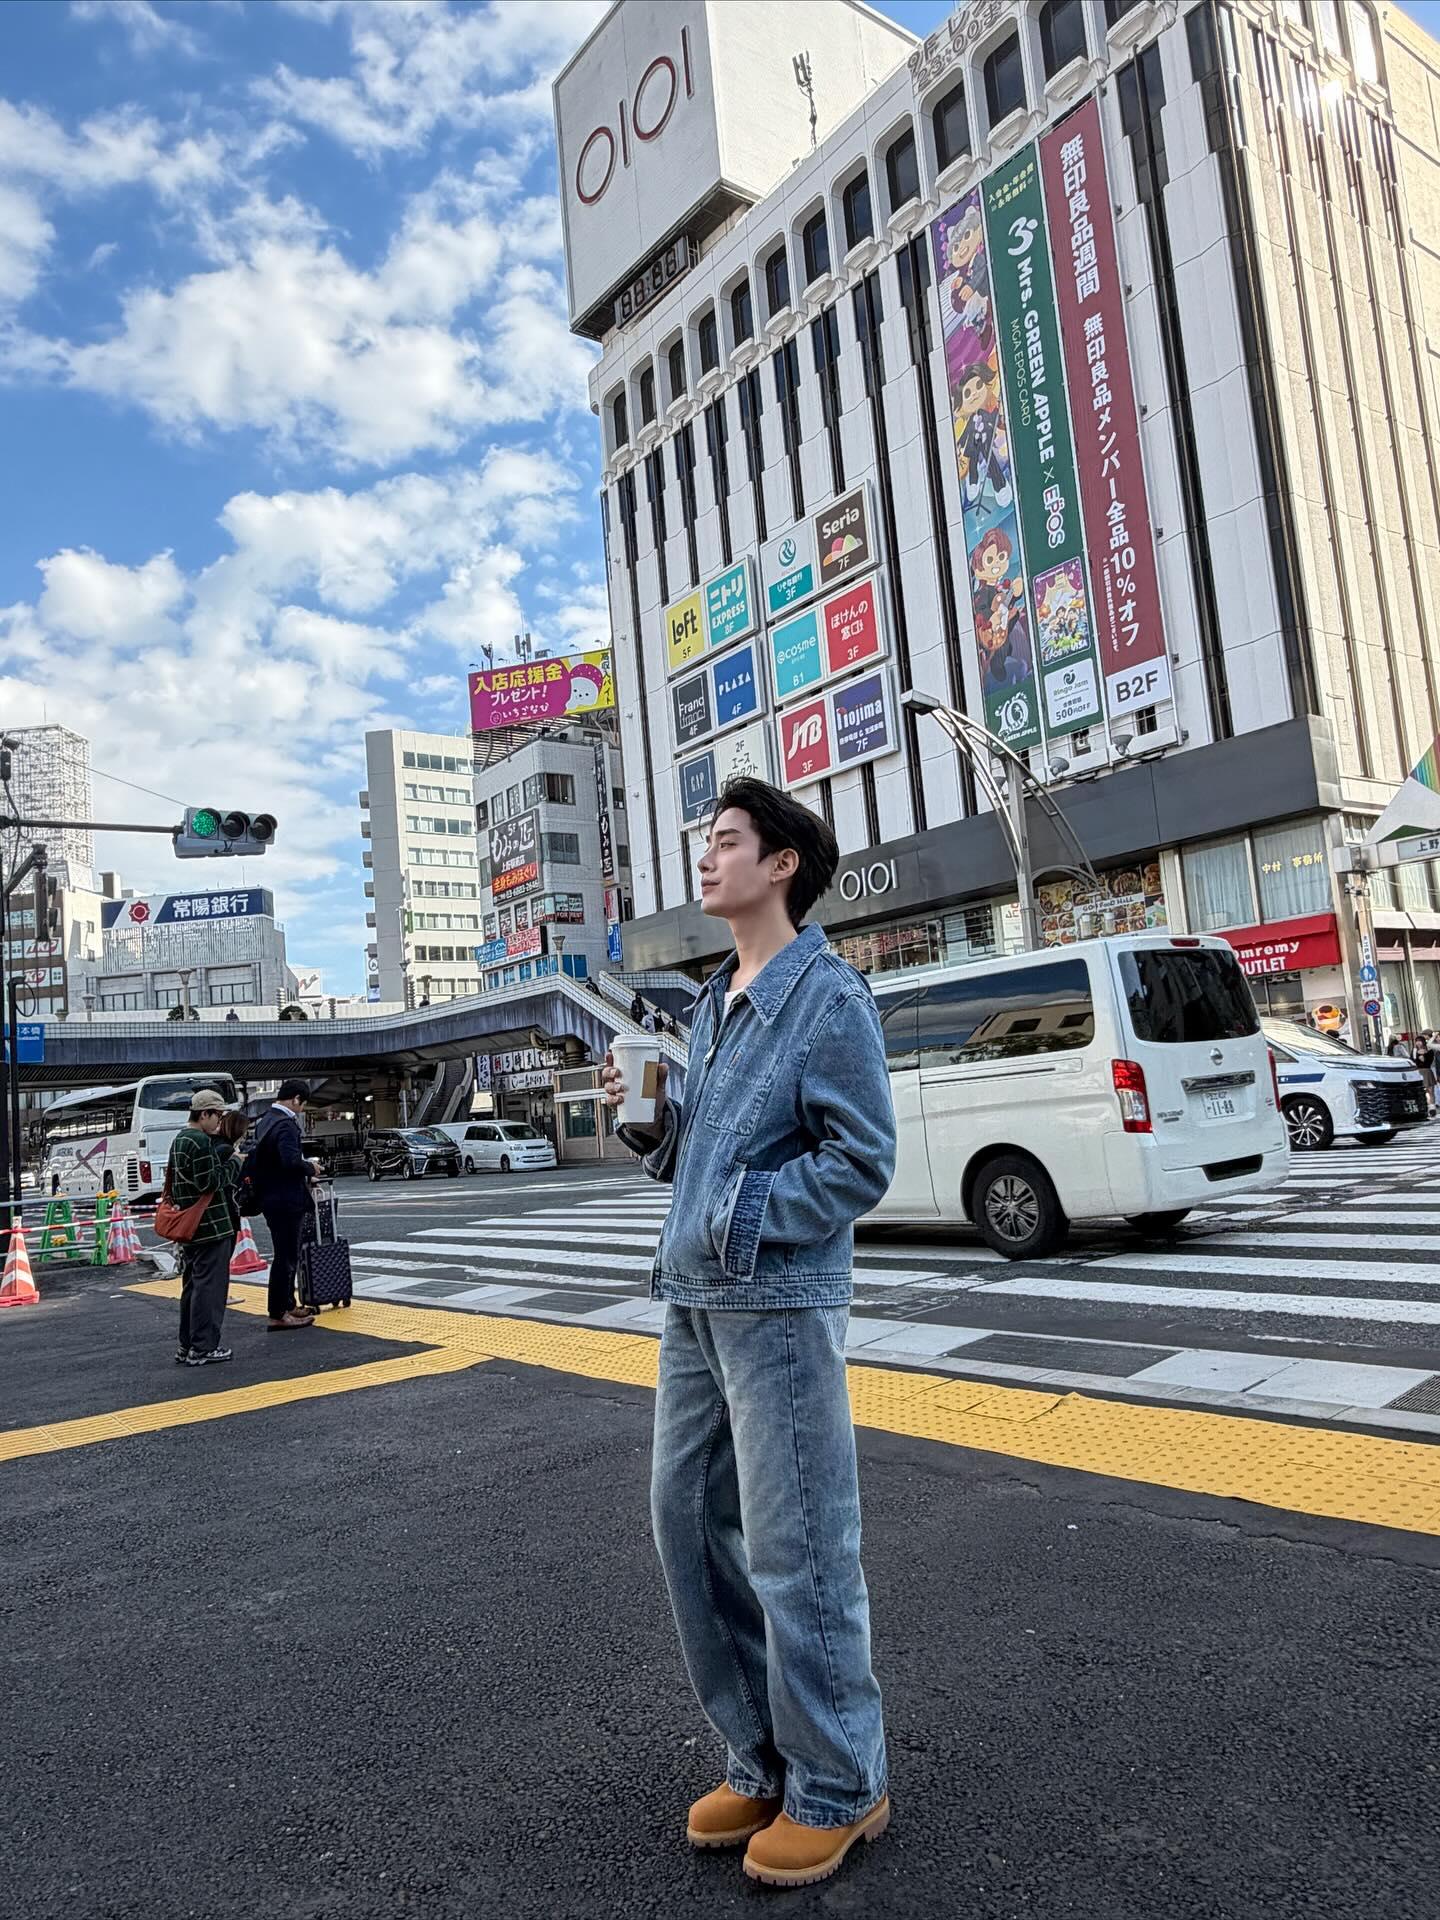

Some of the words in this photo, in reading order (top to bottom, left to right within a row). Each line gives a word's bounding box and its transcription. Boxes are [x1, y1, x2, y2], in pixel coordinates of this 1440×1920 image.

[1060, 133, 1100, 304] 無印良品週間
[1017, 256, 1033, 309] Mrs.
[1024, 309, 1046, 388] GREEN
[1019, 389, 1031, 426] CARD
[1033, 392, 1055, 464] APPLE
[822, 508, 860, 539] Seria
[838, 555, 850, 570] 7F
[710, 574, 743, 613] ニトリ
[785, 589, 796, 601] 3F
[712, 600, 745, 629] EXPRESS
[831, 600, 868, 629] ほけんの
[847, 645, 859, 660] 3F
[473, 662, 563, 695] 入店応援金
[718, 672, 751, 696] PLAZA
[1116, 670, 1159, 703] B2F
[679, 697, 704, 717] Franc
[732, 703, 742, 716] 4F
[689, 724, 699, 737] 4F
[788, 714, 822, 760] JTB
[735, 740, 744, 753] 2F
[856, 737, 868, 752] 7F
[732, 752, 750, 770] エース
[802, 760, 813, 774] 3F
[690, 772, 704, 793] GAP
[172, 893, 249, 918] 常陽銀行
